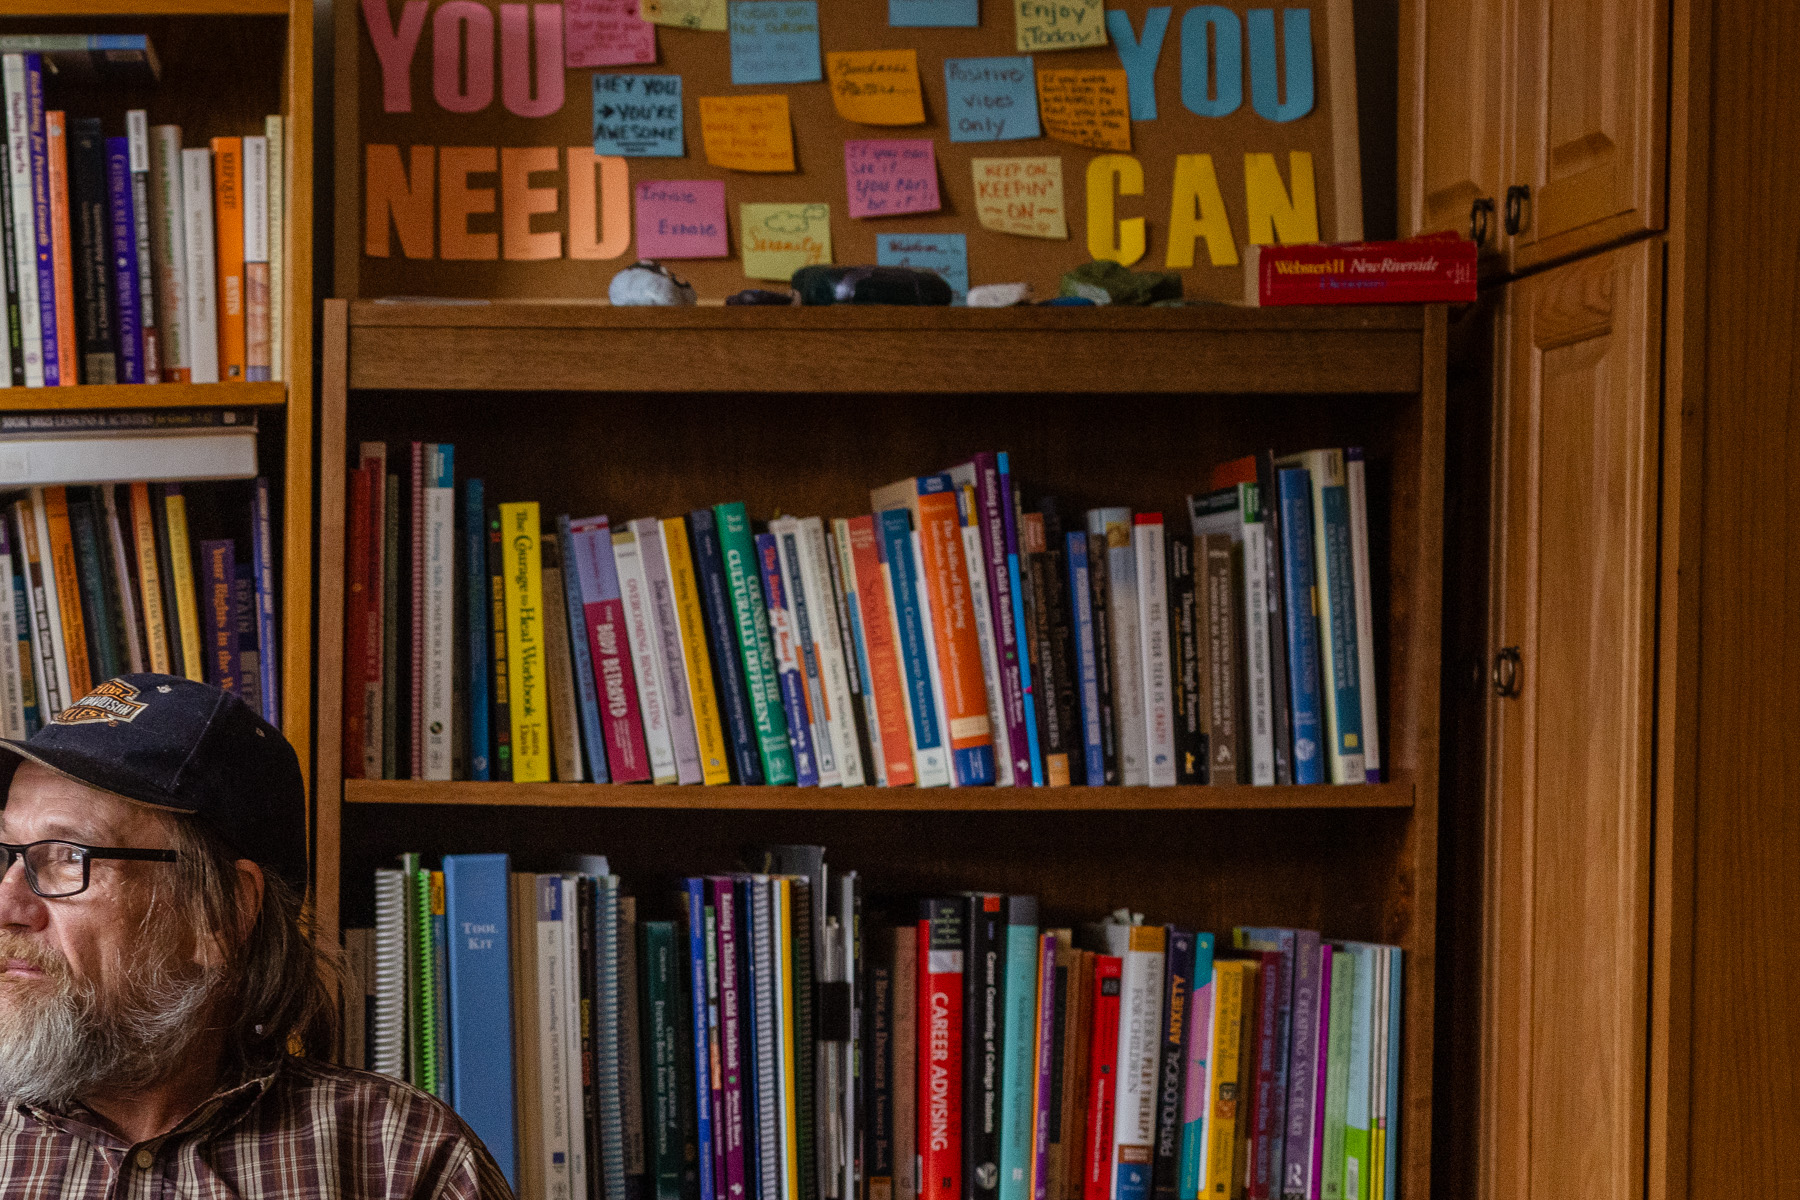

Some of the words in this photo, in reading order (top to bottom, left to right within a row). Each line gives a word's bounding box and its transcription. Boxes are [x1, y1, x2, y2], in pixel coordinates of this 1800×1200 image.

[1021, 2, 1085, 25] Enjoy
[361, 1, 566, 118] YOU
[949, 63, 1024, 82] Positive
[1106, 5, 1315, 123] YOU
[596, 76, 635, 92] HEY
[643, 79, 678, 95] YOU
[12, 92, 25, 132] Healing
[616, 103, 677, 120] YOU'RE
[595, 124, 676, 140] AWESOME
[13, 136, 27, 174] Hearts
[984, 164, 1019, 177] KEEP
[365, 144, 630, 261] NEED
[1086, 150, 1319, 269] CAN
[1382, 255, 1439, 274] Riverside
[517, 510, 529, 532] The
[943, 519, 956, 541] The
[212, 547, 226, 579] Your
[514, 534, 534, 592] Courage
[945, 543, 961, 571] Skills
[949, 573, 961, 584] of
[213, 583, 229, 629] Rights
[950, 585, 967, 629] Helping
[217, 631, 231, 646] in
[518, 607, 536, 643] Heal
[727, 548, 757, 647] CULTURALLY
[745, 650, 771, 733] DIFFERENT
[746, 575, 771, 670] COUNSELING
[763, 671, 779, 703] THE
[219, 650, 233, 673] the
[521, 646, 538, 717] Workbook
[520, 724, 531, 756] Davis
[530, 723, 541, 756] Laura
[462, 922, 497, 934] TOOL
[468, 938, 493, 950] KIT
[722, 943, 735, 988] Thinking
[986, 951, 997, 986] Career
[724, 990, 736, 1017] Child
[984, 986, 996, 1040] Counseling
[1168, 974, 1185, 1045] ANXIETY
[1294, 987, 1312, 1056] CREATING
[726, 1019, 738, 1068] Workbook
[930, 992, 949, 1061] CAREER
[986, 1041, 996, 1052] of
[983, 1054, 996, 1089] College
[1142, 1057, 1154, 1087] PLAY
[930, 1064, 948, 1151] ADVISING
[984, 1092, 994, 1133] Students
[1138, 1090, 1152, 1140] THERAPY
[1160, 1050, 1180, 1158] PATHOLOGICAL
[1291, 1061, 1306, 1137] SANCTUARY
